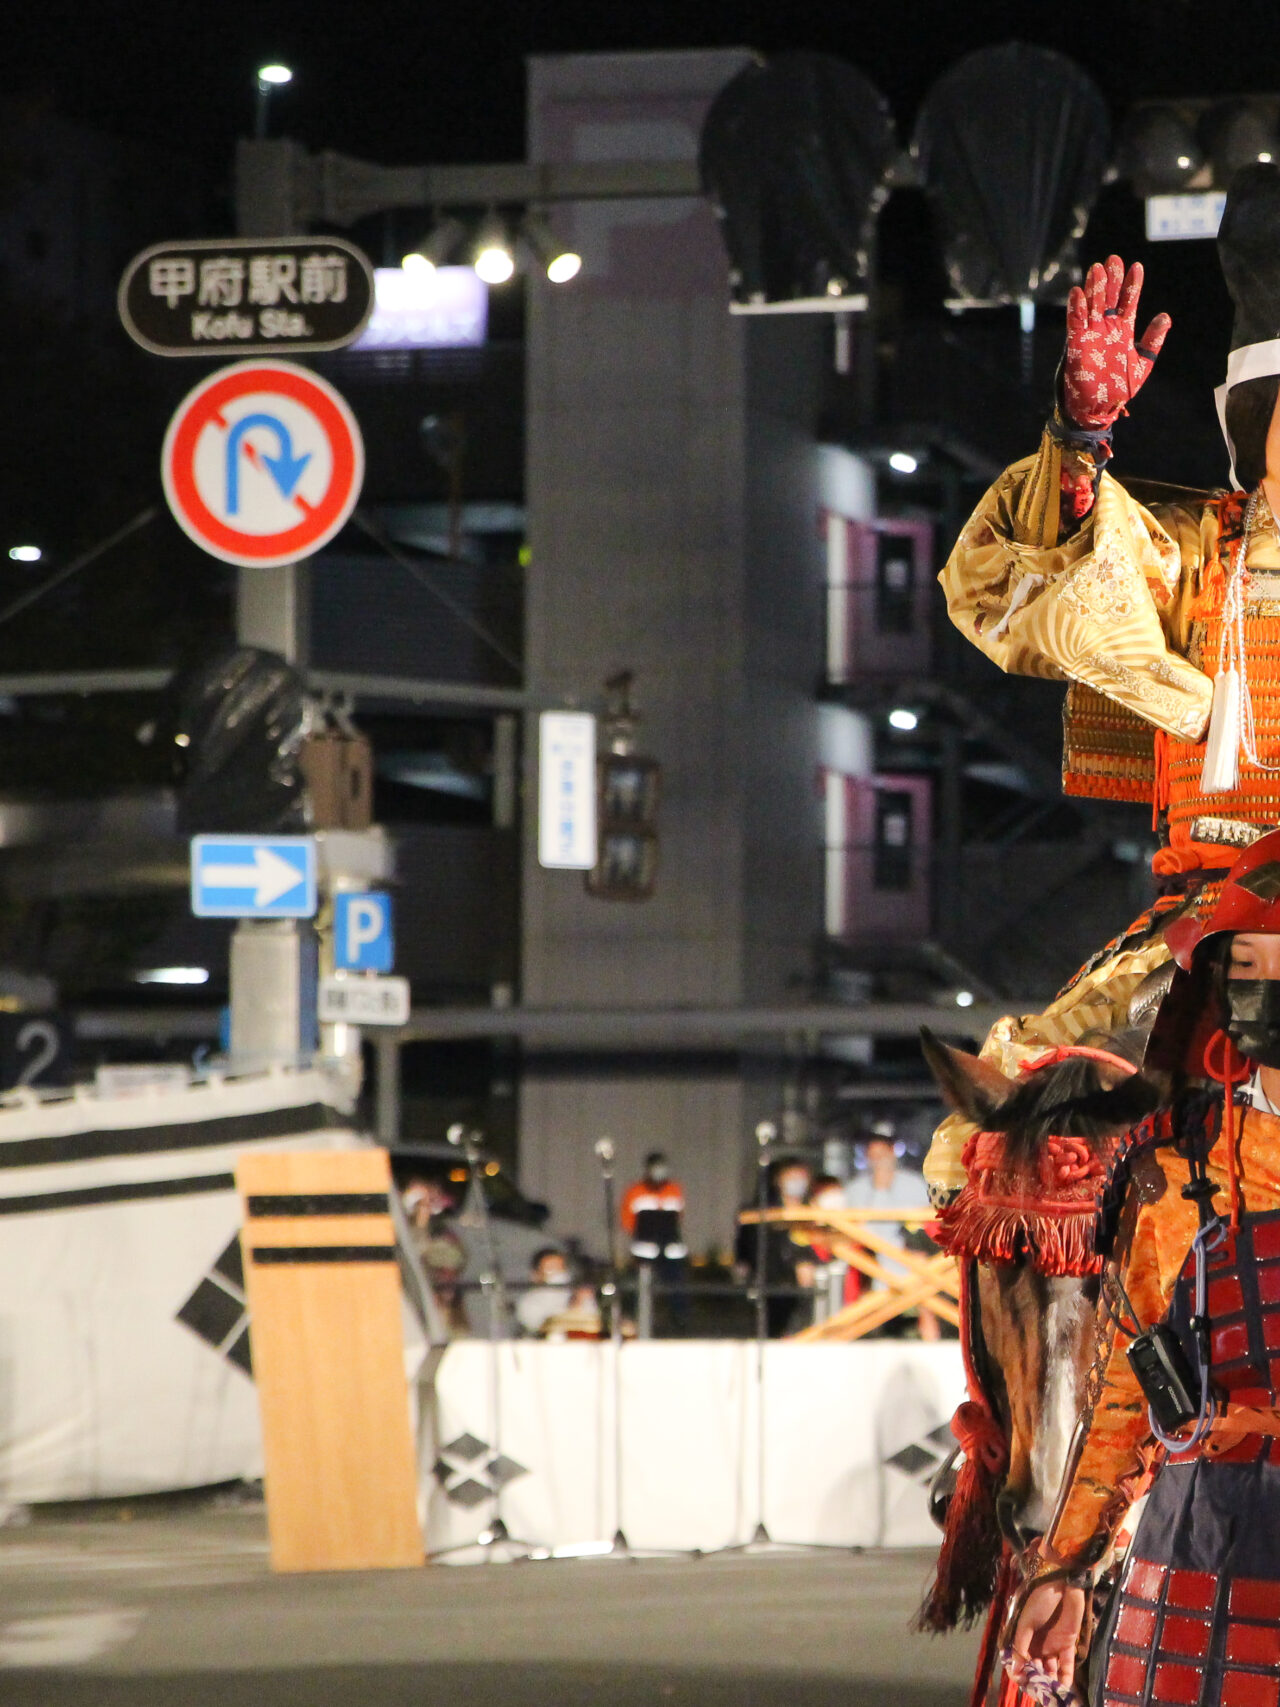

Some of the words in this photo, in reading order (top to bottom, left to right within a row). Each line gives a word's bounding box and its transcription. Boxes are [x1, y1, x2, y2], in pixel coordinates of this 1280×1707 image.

[150, 254, 348, 310] 甲府駅前
[191, 310, 254, 341] Kofu
[258, 308, 314, 338] Sta.
[347, 900, 384, 964] P
